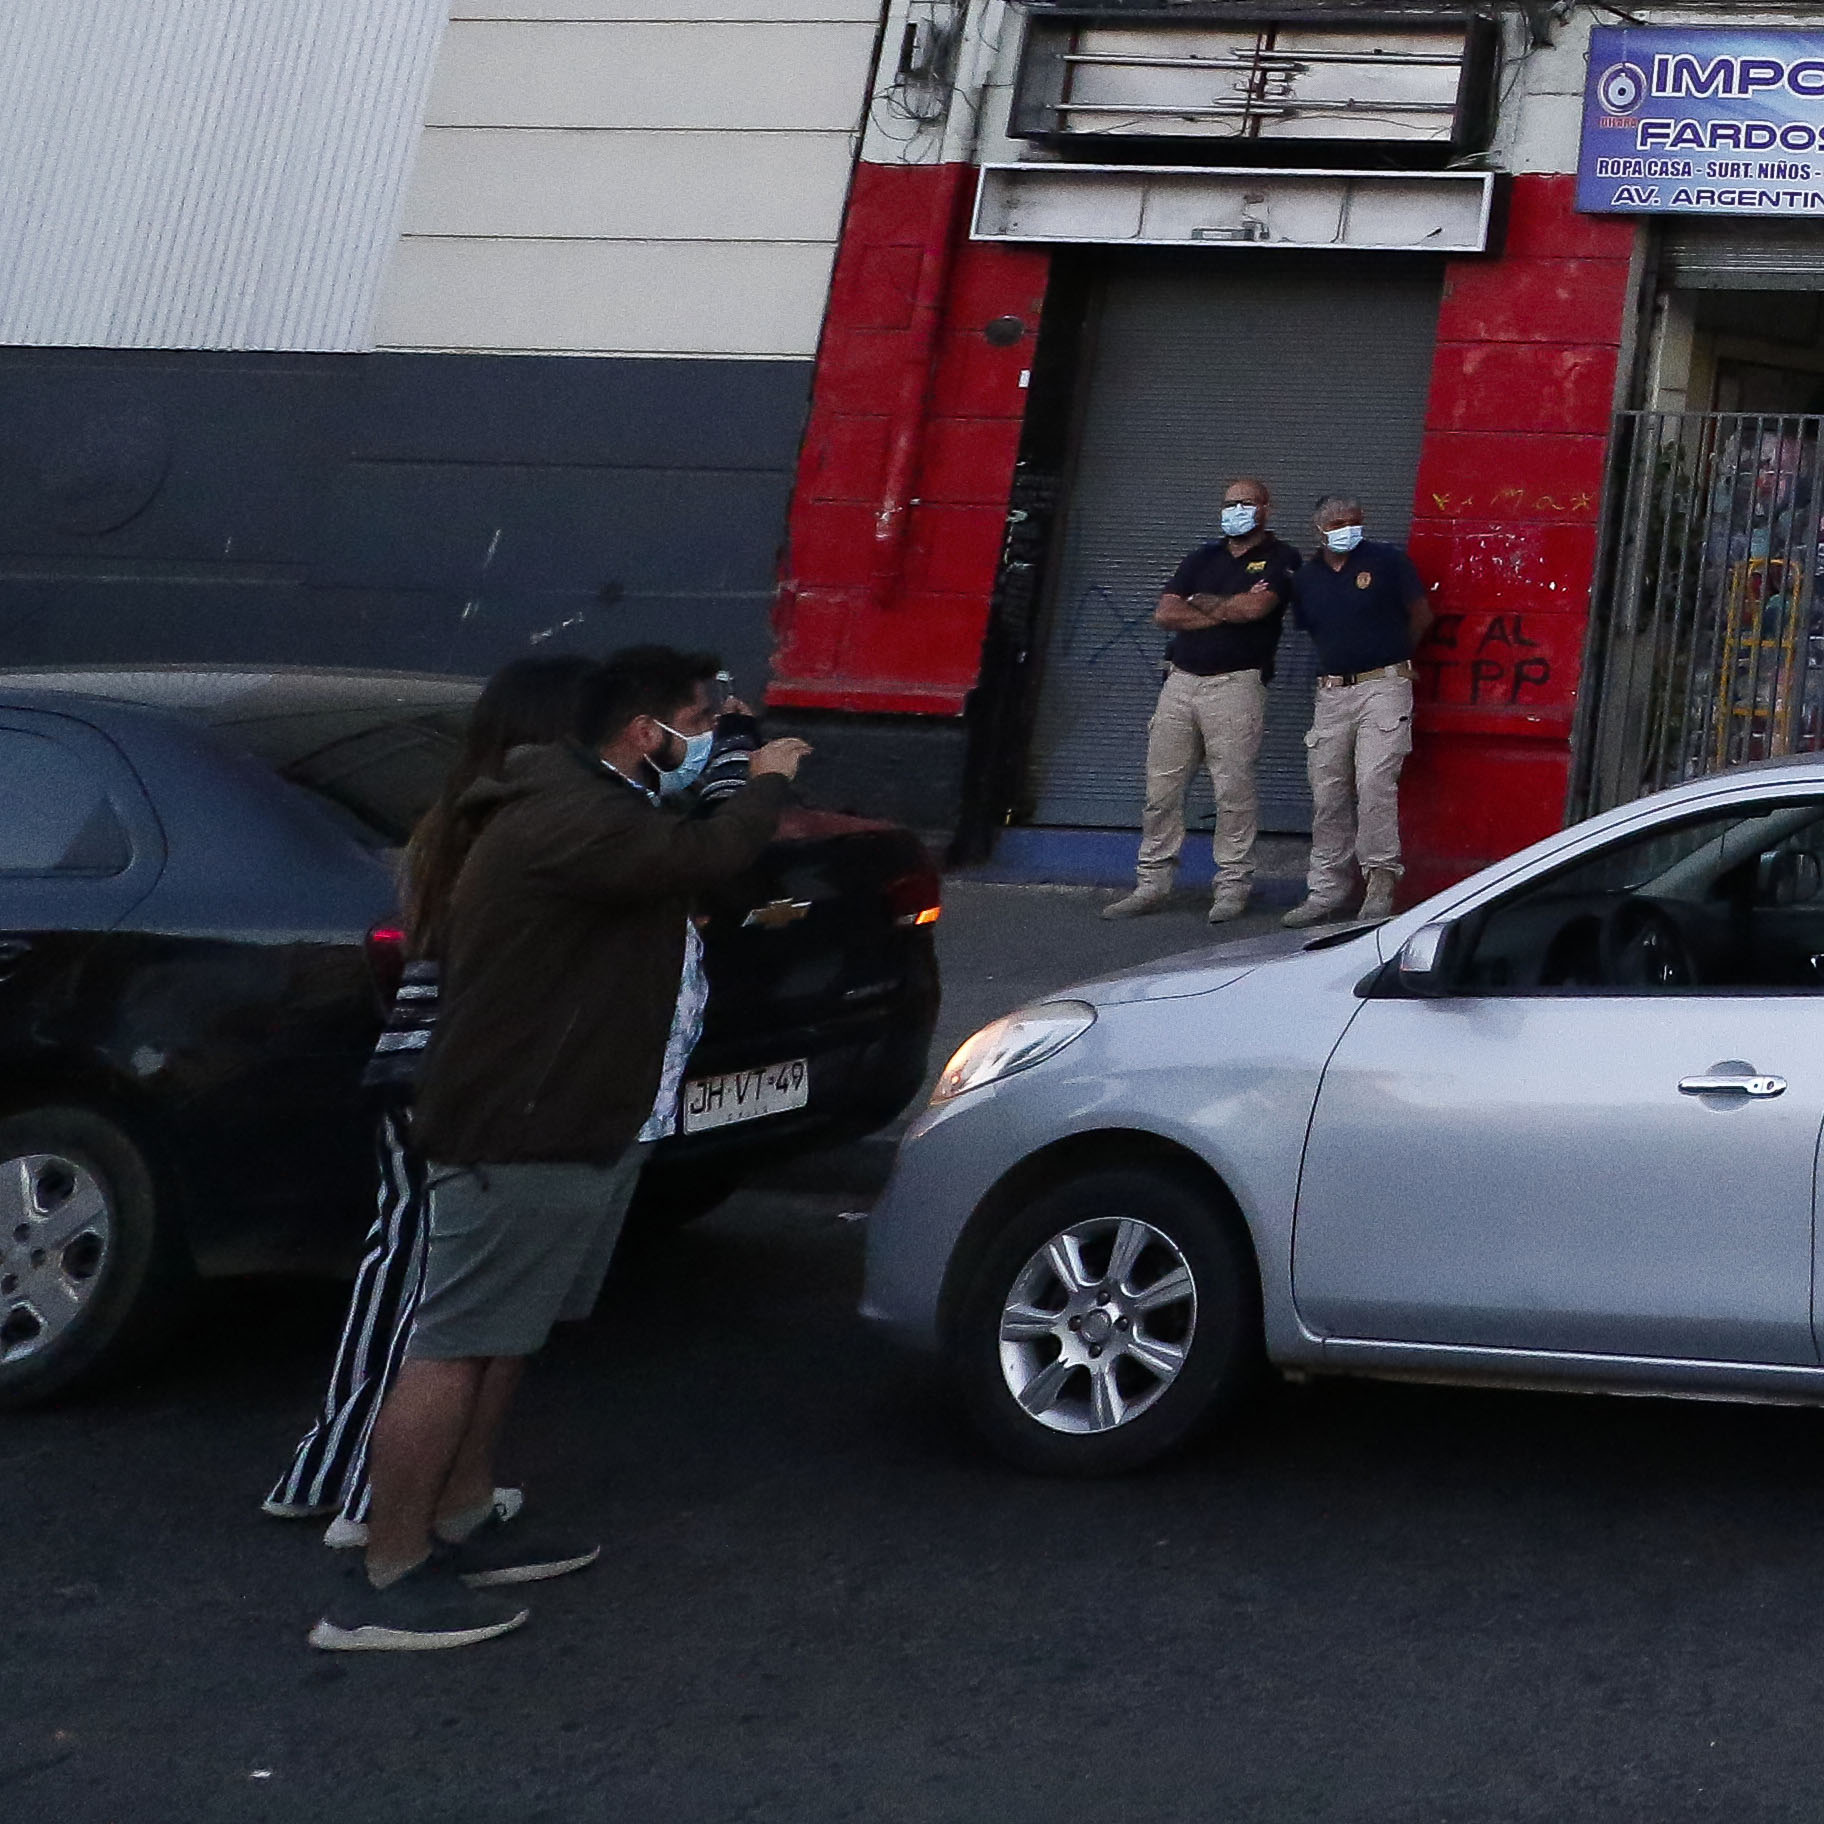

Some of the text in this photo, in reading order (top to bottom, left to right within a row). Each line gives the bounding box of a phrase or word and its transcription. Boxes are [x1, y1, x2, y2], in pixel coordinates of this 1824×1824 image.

[1598, 158, 1642, 177] ROPA
[1647, 159, 1692, 178] CASA
[1706, 160, 1754, 179] SURT.
[1757, 160, 1812, 181] NIÑOS
[1610, 185, 1659, 206] AV.
